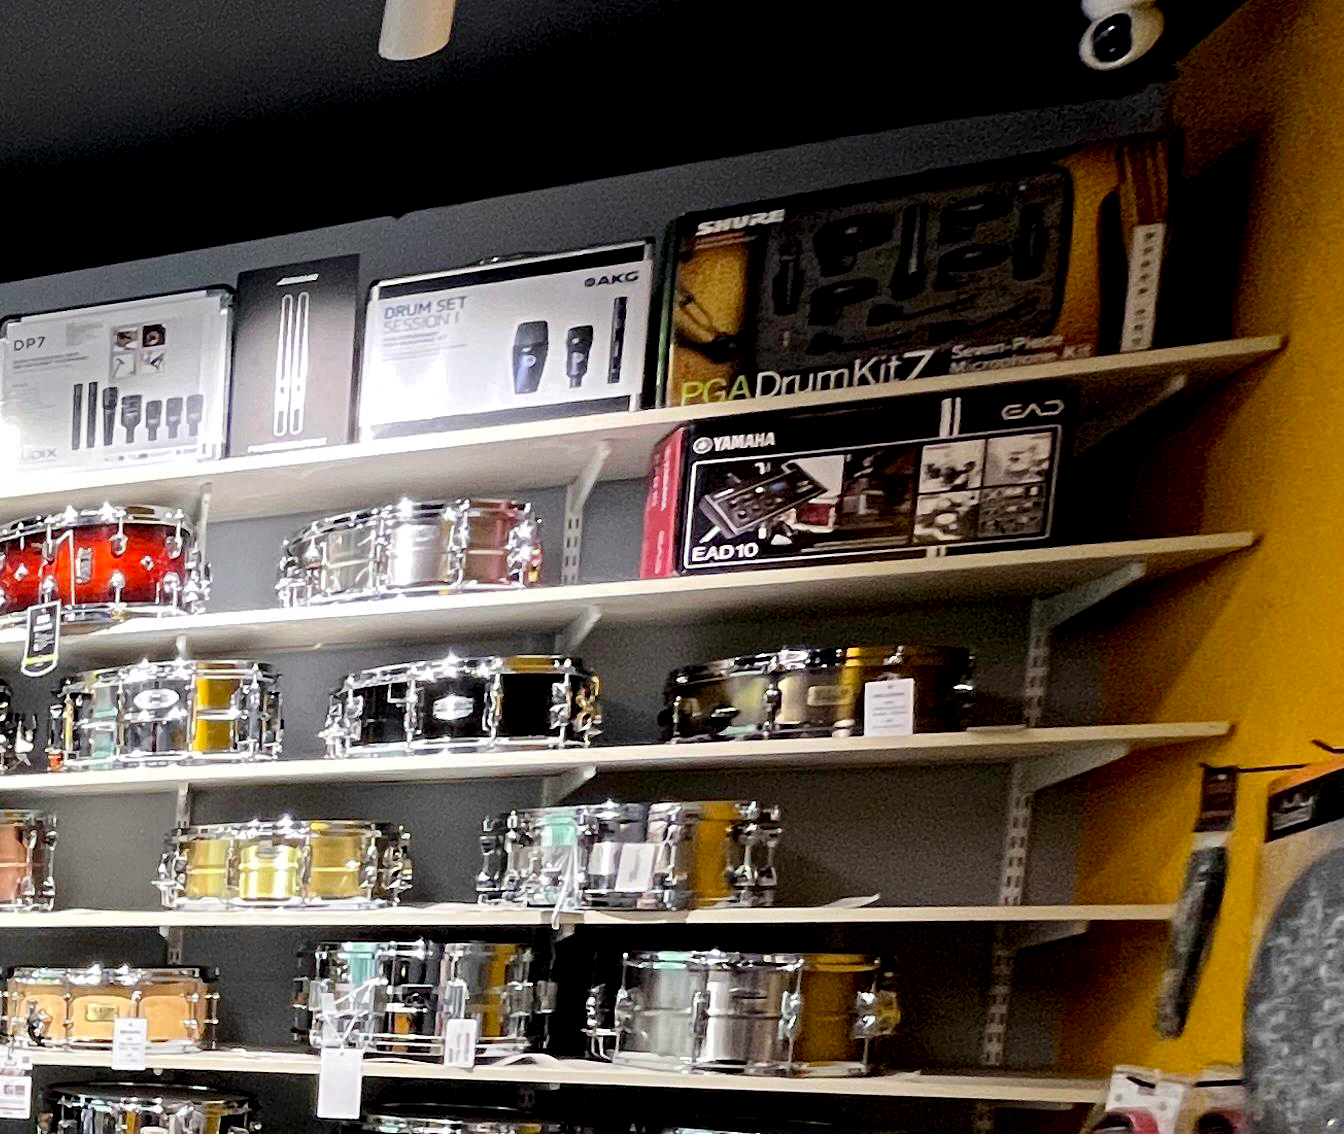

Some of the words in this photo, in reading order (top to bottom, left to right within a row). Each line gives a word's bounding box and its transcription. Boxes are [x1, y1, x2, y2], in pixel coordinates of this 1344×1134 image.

[695, 209, 786, 237] SHURE
[596, 271, 640, 286] AKG
[384, 302, 432, 320] DRUM
[436, 295, 469, 313] SET
[383, 313, 450, 334] SESSION
[13, 336, 46, 352] DP7
[713, 432, 776, 451] YAMAHA
[692, 543, 760, 563] EAD10
